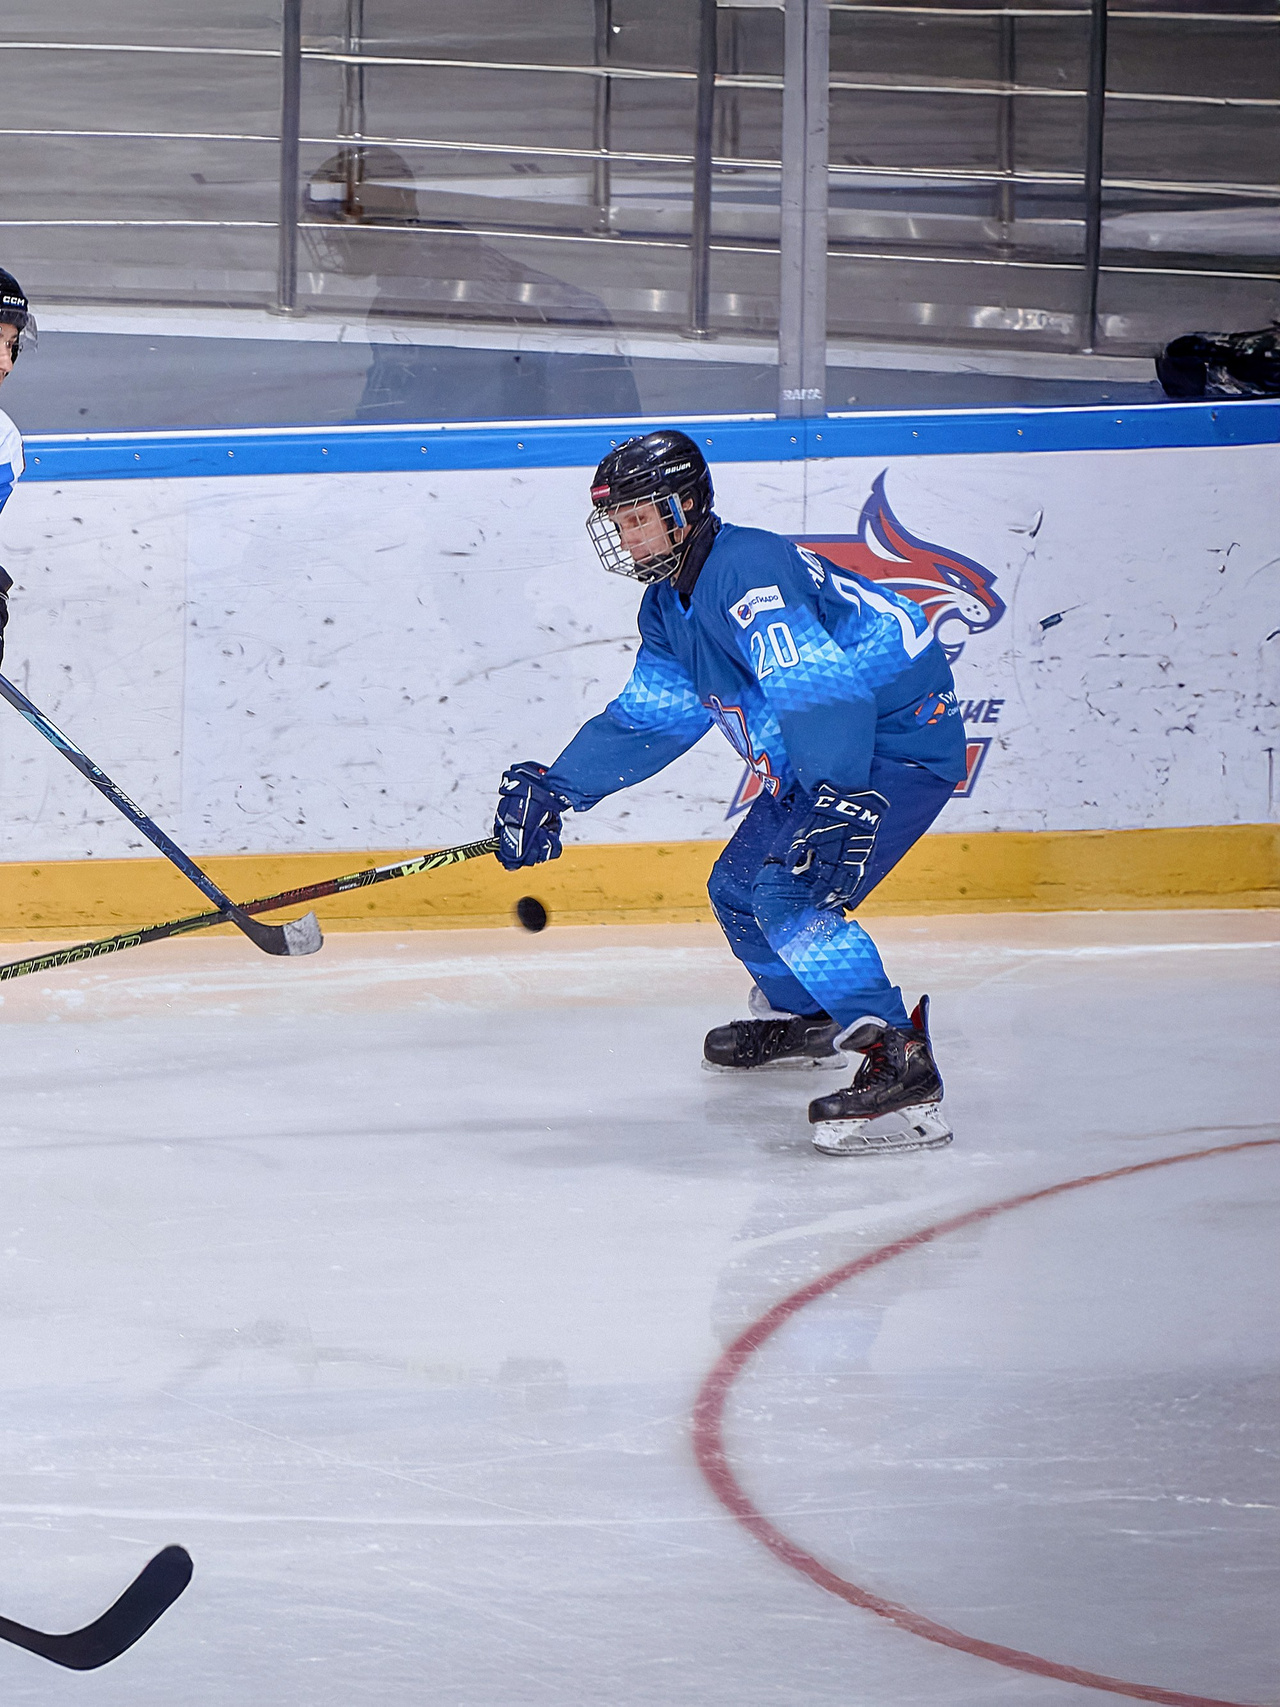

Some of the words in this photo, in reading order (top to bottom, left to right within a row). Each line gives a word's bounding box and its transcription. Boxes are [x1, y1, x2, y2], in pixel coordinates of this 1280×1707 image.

[3, 295, 25, 306] CCM
[750, 622, 800, 681] 20
[814, 796, 880, 825] CCM
